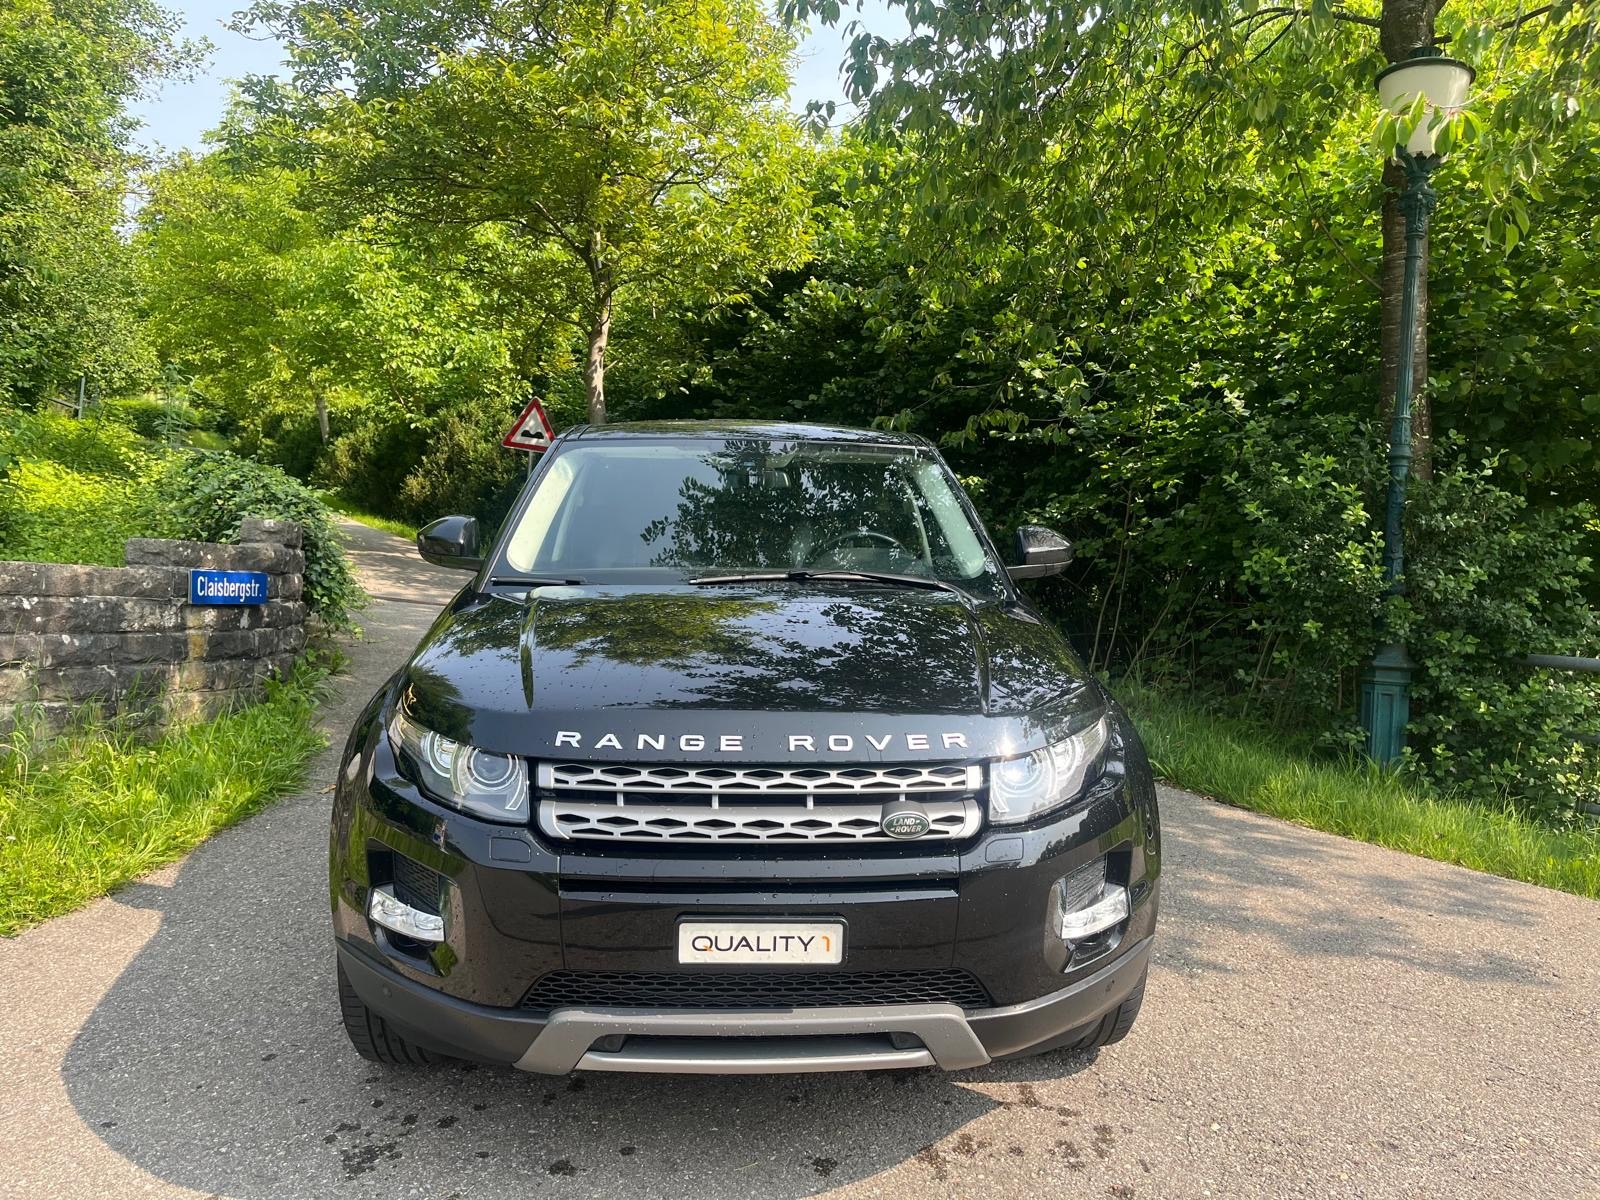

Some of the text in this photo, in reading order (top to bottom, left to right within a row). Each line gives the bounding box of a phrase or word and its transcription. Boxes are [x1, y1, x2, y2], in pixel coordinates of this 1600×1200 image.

[197, 576, 262, 602] Claisbergstr.
[555, 731, 969, 752] RANGE ROVER
[691, 935, 831, 952] QUALITY 1
